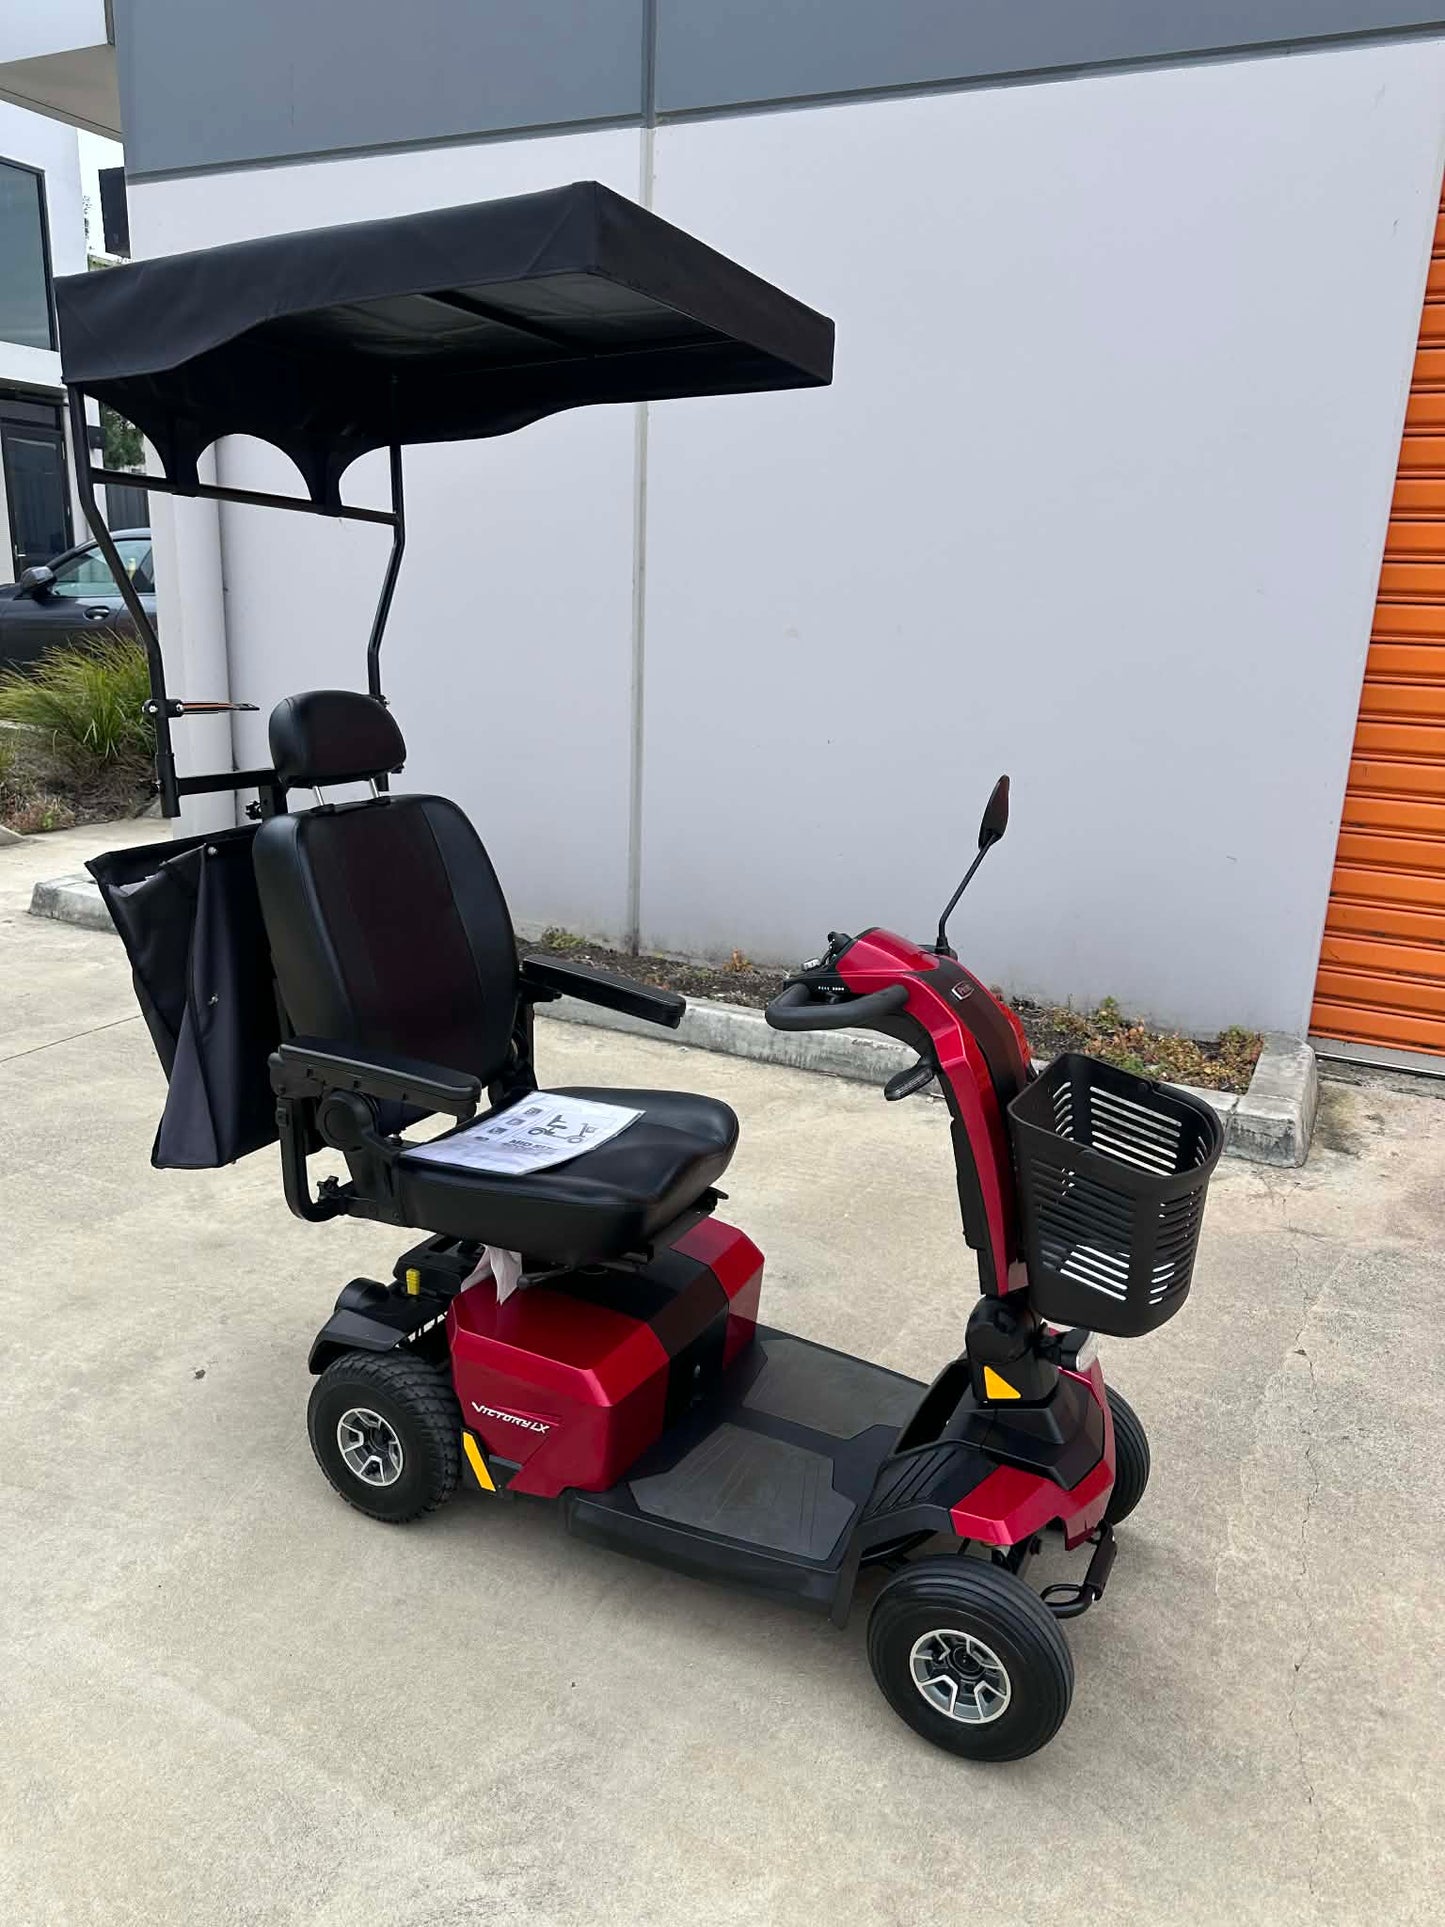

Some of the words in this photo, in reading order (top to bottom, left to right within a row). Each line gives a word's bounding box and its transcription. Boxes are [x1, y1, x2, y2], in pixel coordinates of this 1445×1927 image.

[509, 1139, 533, 1147] MID
[471, 1401, 532, 1428] VICTORY
[530, 1422, 550, 1434] LX
